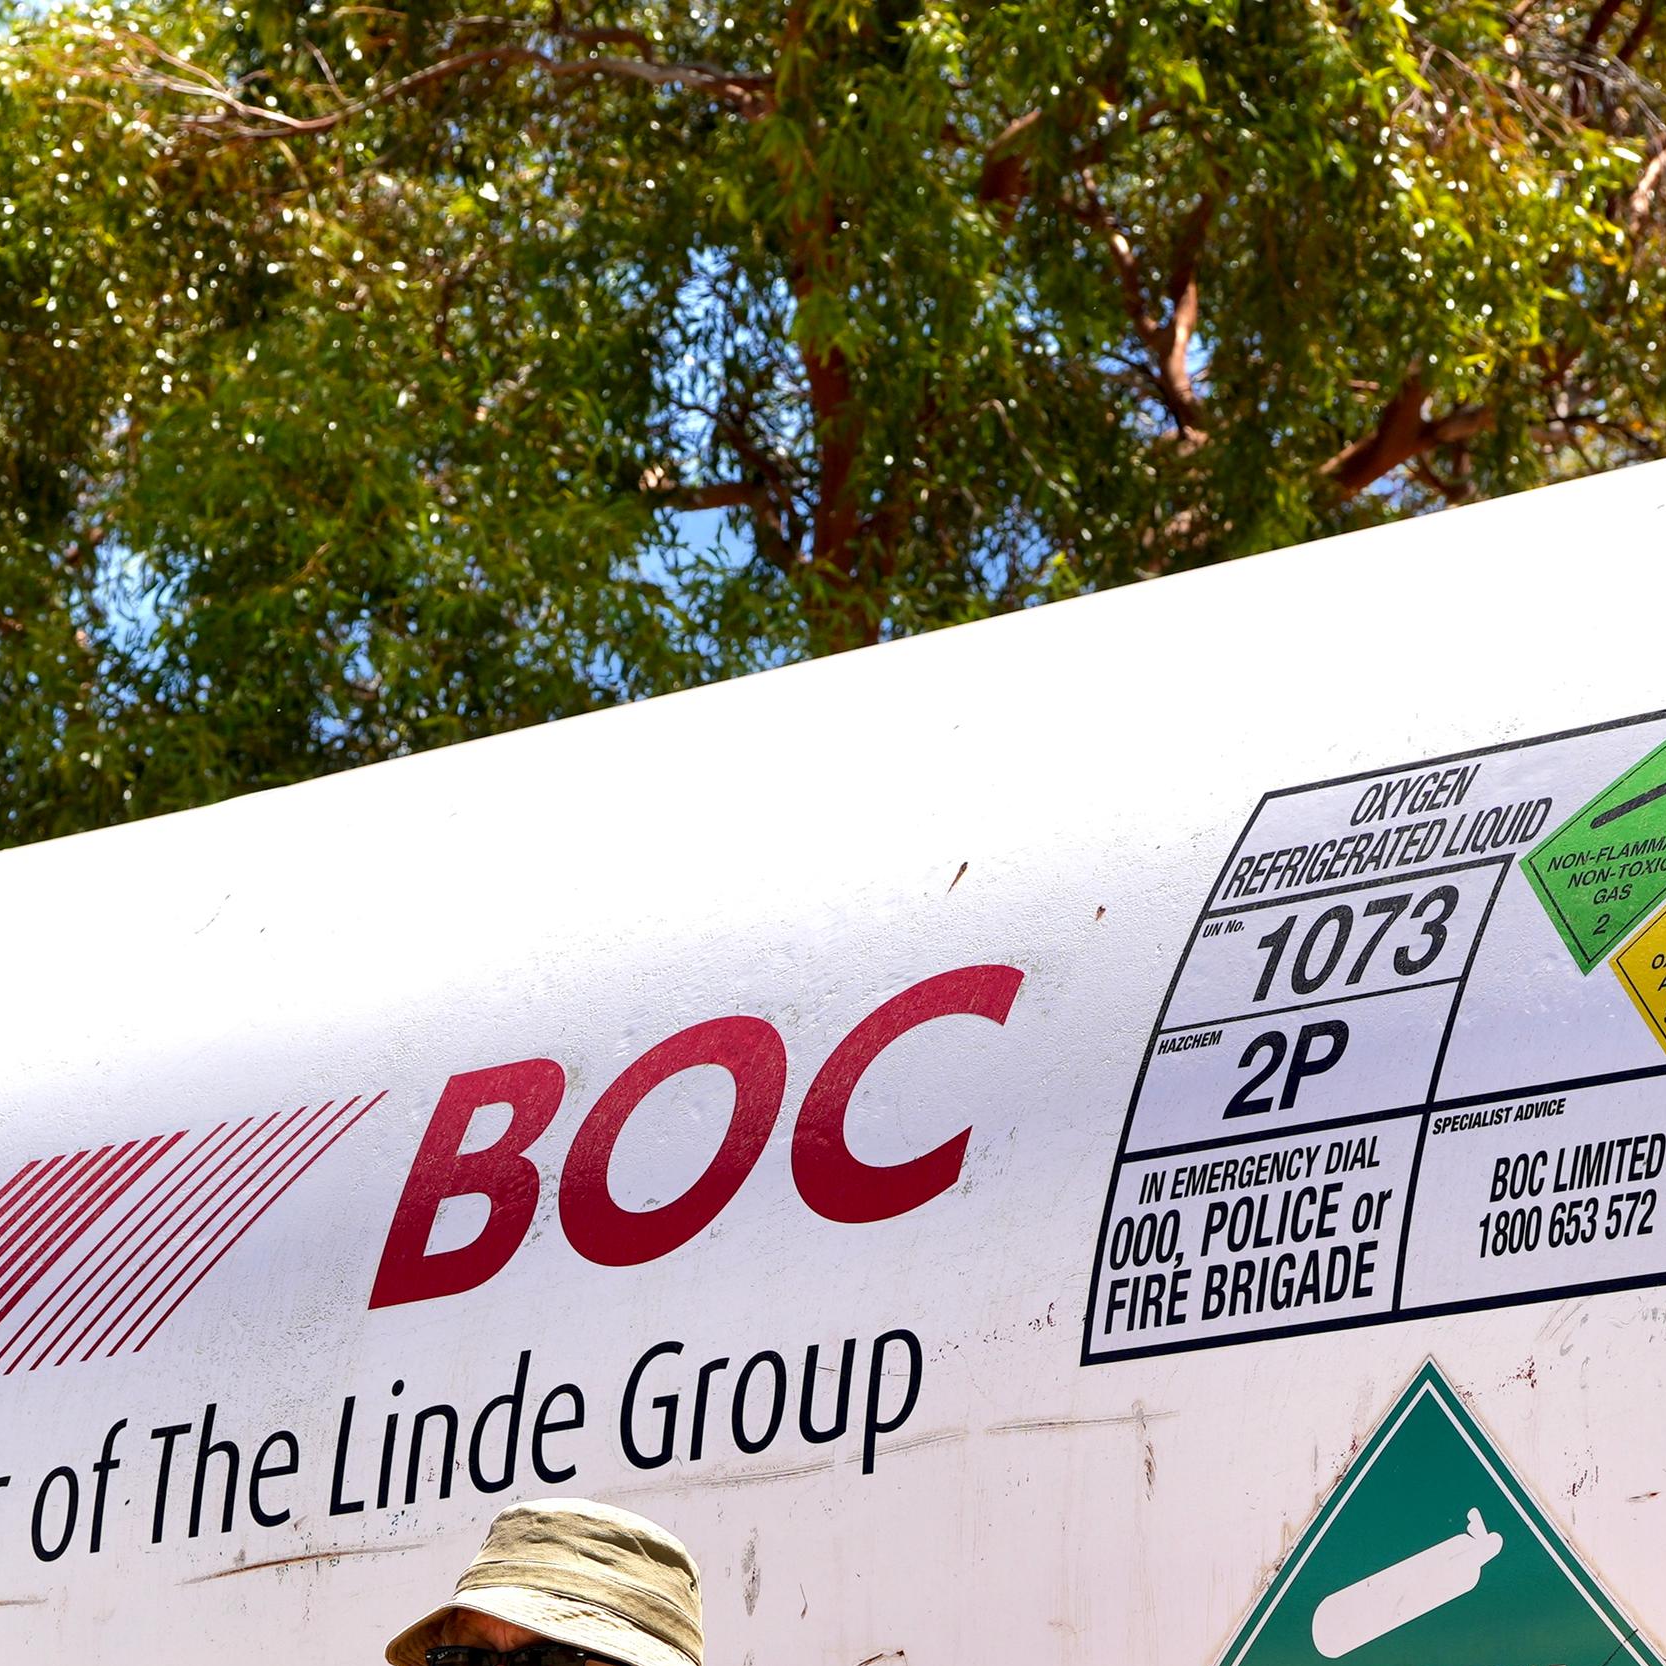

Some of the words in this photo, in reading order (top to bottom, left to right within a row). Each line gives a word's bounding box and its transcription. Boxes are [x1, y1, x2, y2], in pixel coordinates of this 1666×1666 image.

[1350, 763, 1481, 826] OXYGEN
[1222, 818, 1447, 900] REFRIGERATED
[1442, 797, 1552, 857] LIQUID
[1203, 922, 1223, 938] UN
[1224, 917, 1245, 934] No.
[1591, 914, 1610, 937] 2
[1594, 884, 1632, 904] GAS
[1253, 886, 1459, 1002] 1073
[1157, 1030, 1223, 1055] HAZCHEM
[1223, 1020, 1349, 1119] 2P
[368, 964, 1025, 1310] BOC
[1433, 1107, 1513, 1135] SPECIALIST
[1514, 1098, 1566, 1122] ADVICE
[1139, 1171, 1166, 1204] IN
[1170, 1145, 1321, 1199] EMERGENCY
[1325, 1136, 1379, 1174] DIAL
[1490, 1151, 1547, 1202] BOC
[1553, 1133, 1666, 1193] LIMITED
[1110, 1210, 1183, 1270] 000,
[1201, 1182, 1343, 1256] POLICE
[1352, 1189, 1392, 1233] or
[1480, 1206, 1542, 1258] 1800
[1549, 1198, 1598, 1248] 653
[1605, 1189, 1656, 1239] 572
[1104, 1269, 1191, 1334] FIRE
[1202, 1241, 1378, 1320] BRIGADE
[31, 1418, 128, 1562] of
[151, 1403, 299, 1544] The
[329, 1350, 584, 1516] Linde
[620, 1329, 922, 1475] Group
